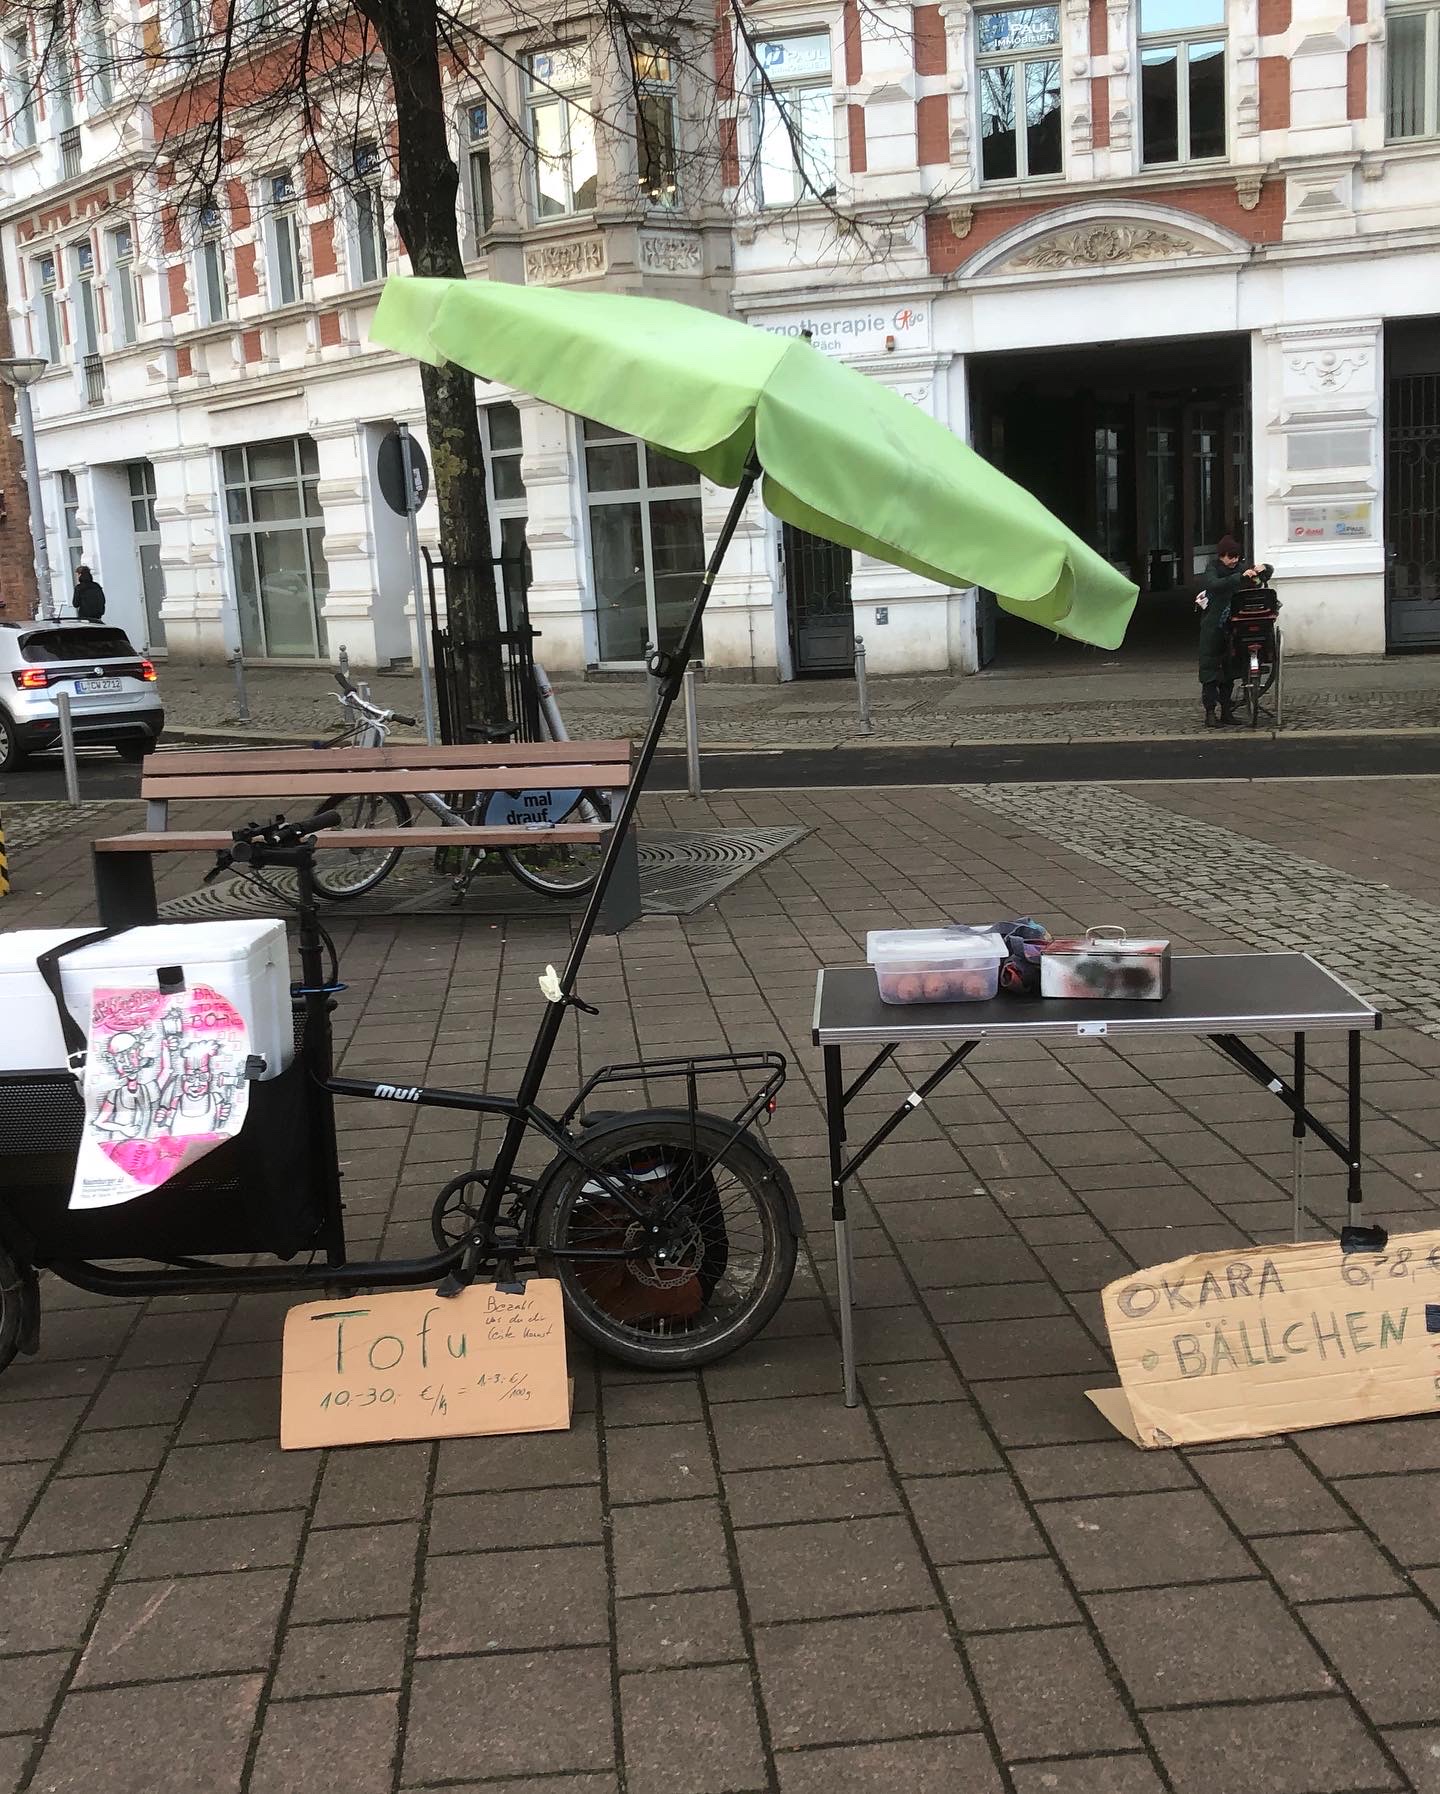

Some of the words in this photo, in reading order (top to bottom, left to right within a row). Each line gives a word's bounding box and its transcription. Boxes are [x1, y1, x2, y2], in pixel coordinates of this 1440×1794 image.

[1011, 22, 1054, 35] PAUL
[994, 33, 1054, 47] IMMOBILIEN
[524, 791, 552, 807] mal
[506, 809, 552, 825] drauf.
[1117, 1257, 1285, 1318] OKARA
[310, 1306, 467, 1374] Tofu
[1173, 1306, 1408, 1378] BÄLLCHEN
